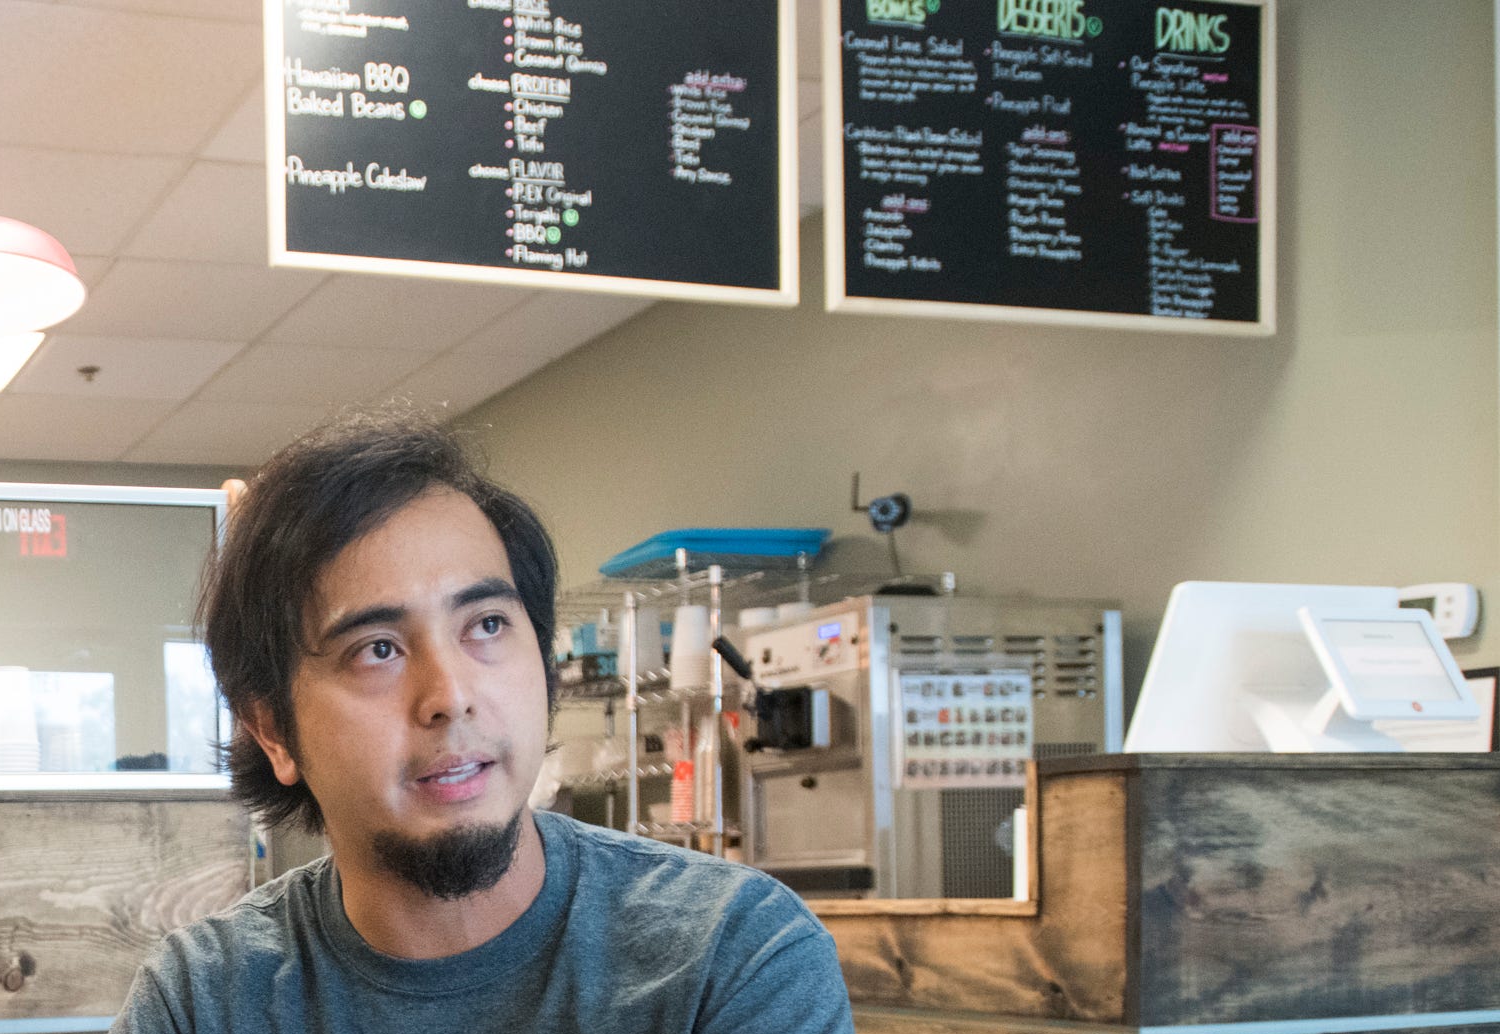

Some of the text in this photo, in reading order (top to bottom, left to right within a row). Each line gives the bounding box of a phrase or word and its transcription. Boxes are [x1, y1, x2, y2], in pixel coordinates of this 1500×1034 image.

[514, 16, 582, 38] White Rice
[997, 0, 1086, 39] DESSERTS
[1155, 7, 1231, 53] DRINKS
[514, 31, 583, 56] Brown Rice
[844, 30, 889, 51] Coconut
[927, 36, 964, 56] Salad
[992, 40, 1038, 64] Pineapple
[514, 48, 564, 69] Coconut
[286, 56, 410, 93] Hawaiian BBQ
[510, 73, 571, 95] PROTEIN
[287, 87, 344, 117] Baked
[351, 91, 406, 120] Beans
[513, 98, 564, 118] Chicken
[992, 91, 1040, 116] Pineapple
[516, 134, 545, 153] Tofu
[287, 155, 427, 194] Pineapple Coleslaw
[509, 158, 564, 180] FLAVOR
[545, 186, 592, 209] Original
[513, 222, 546, 245] BBQ
[512, 244, 588, 271] Flaming Hot
[3, 507, 18, 533] ON
[19, 507, 52, 534] GLASS
